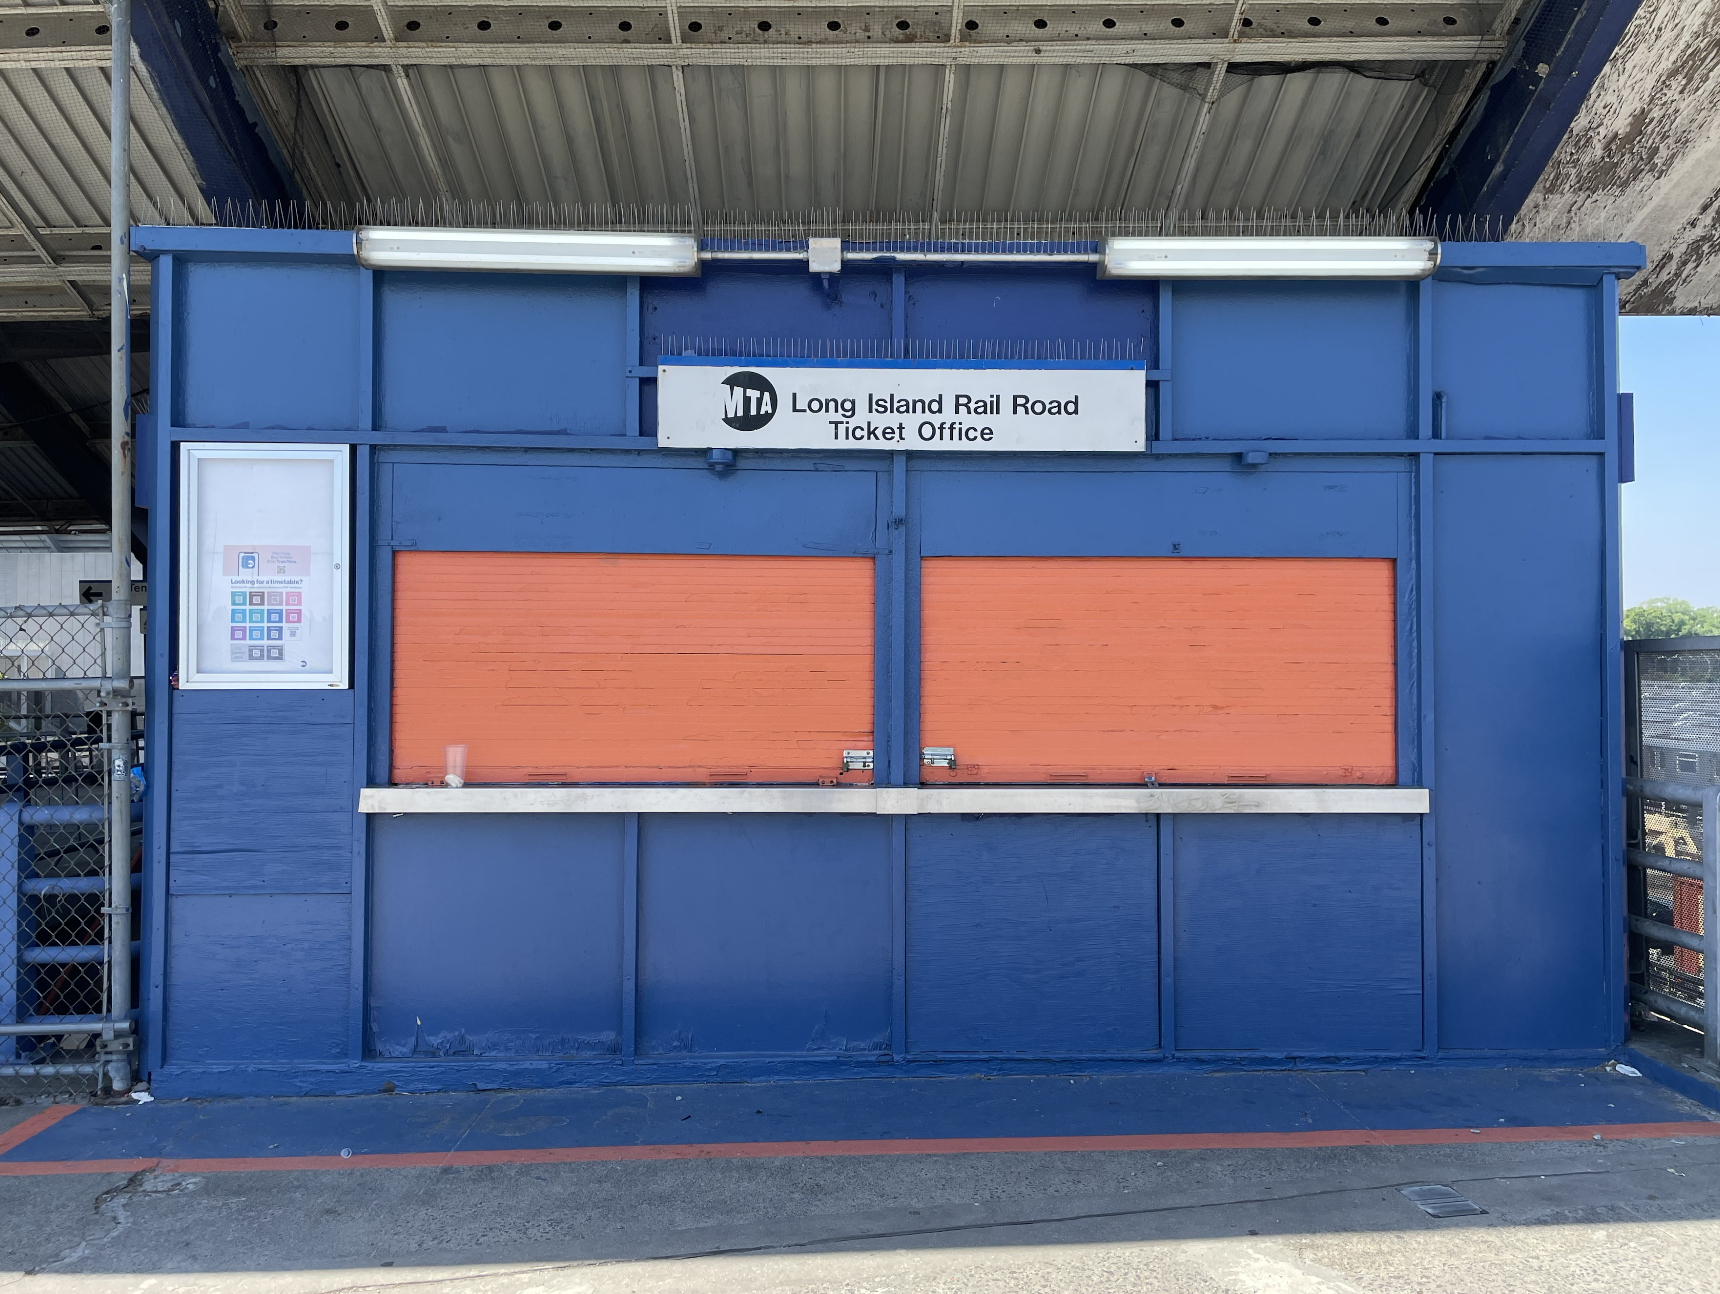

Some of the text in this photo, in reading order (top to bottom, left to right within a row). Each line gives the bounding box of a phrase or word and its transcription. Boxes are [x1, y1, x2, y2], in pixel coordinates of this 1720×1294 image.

[721, 384, 773, 418] MTA
[792, 393, 1079, 419] Long Island Rail Road
[828, 420, 994, 442] Ticket Office
